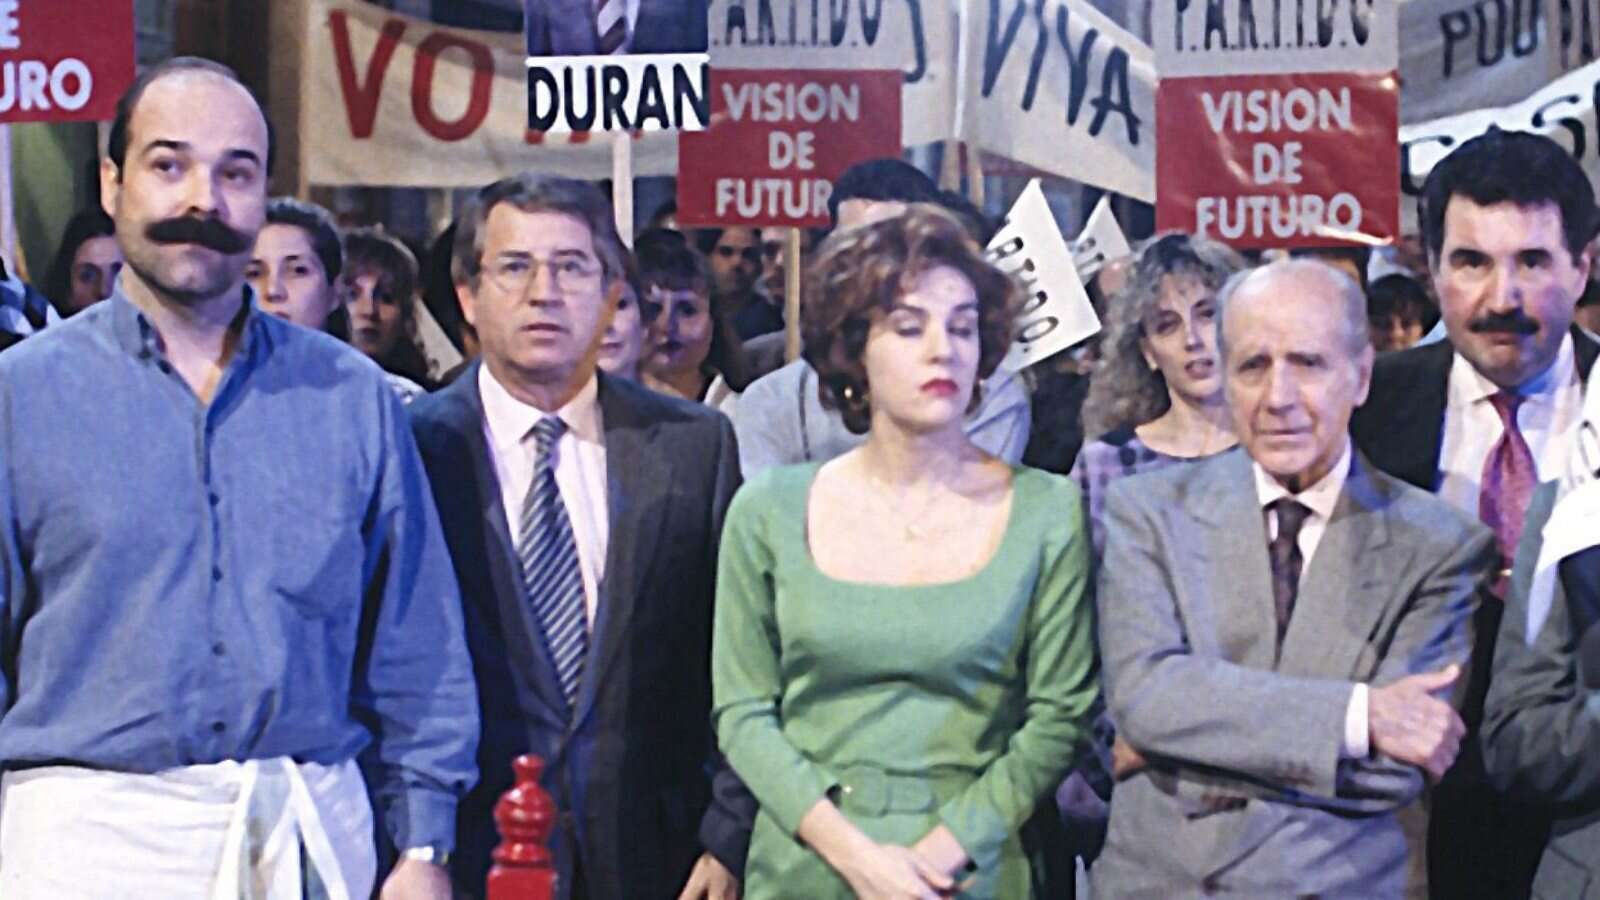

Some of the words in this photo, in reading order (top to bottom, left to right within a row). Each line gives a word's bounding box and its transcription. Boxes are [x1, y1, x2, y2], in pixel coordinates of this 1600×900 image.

[527, 63, 711, 131] DURAN
[721, 82, 860, 123] VISION
[1200, 86, 1352, 134] VISION
[768, 131, 815, 170] DE
[1253, 141, 1303, 186] DE
[715, 178, 834, 218] FUTUR
[1195, 192, 1364, 240] FUTURO
